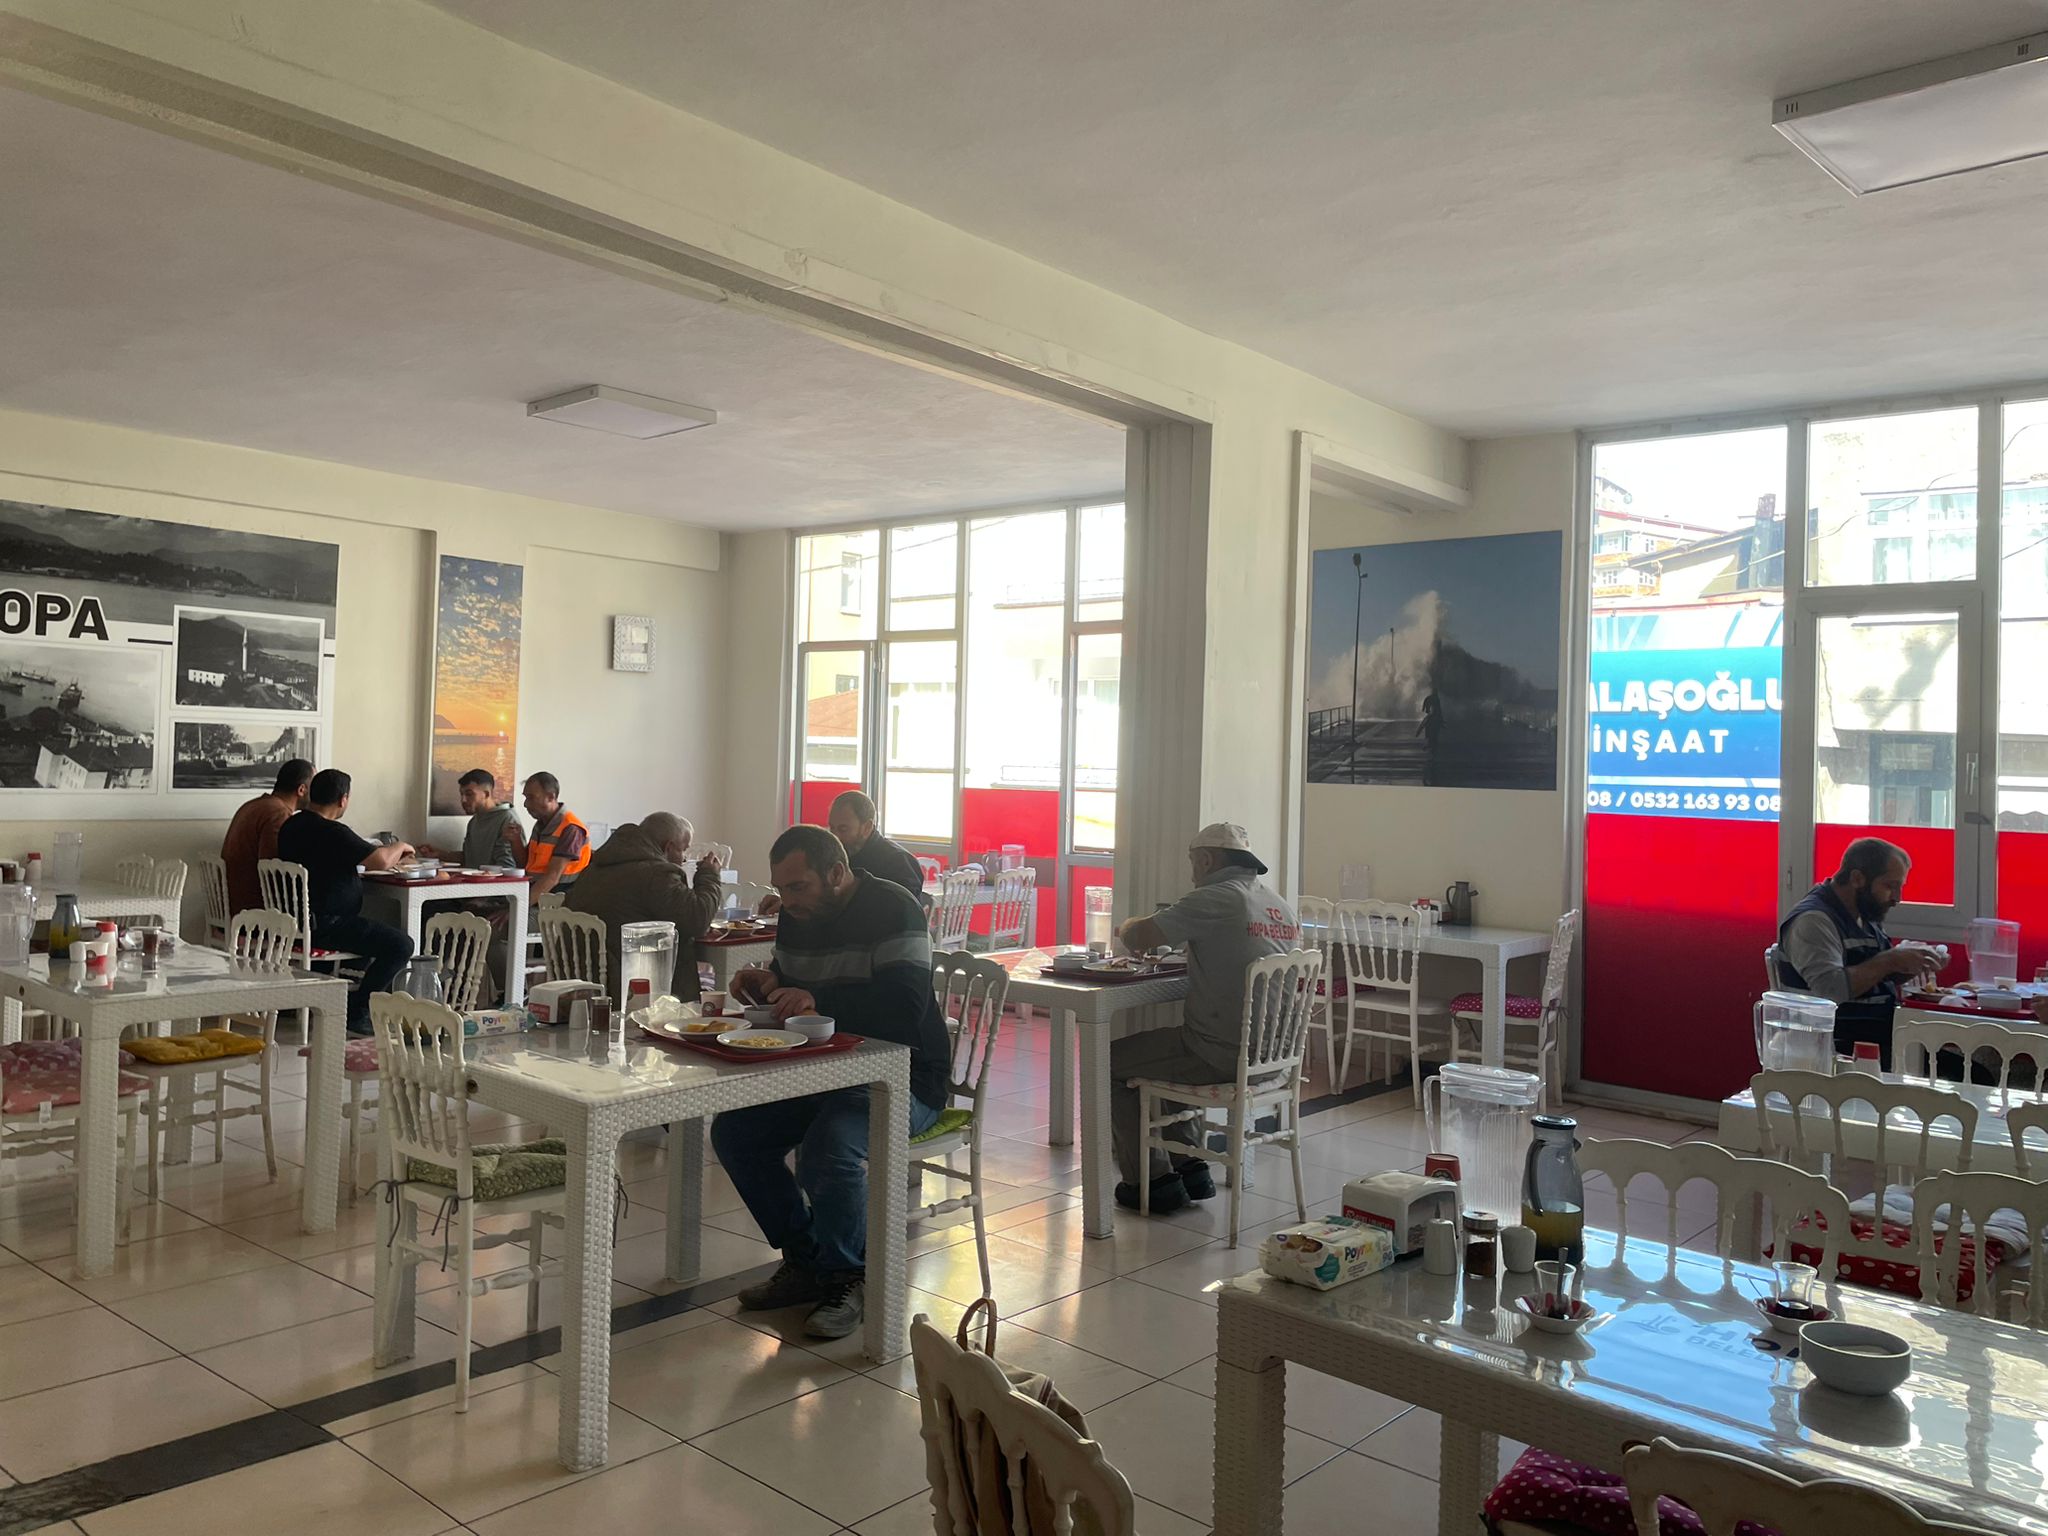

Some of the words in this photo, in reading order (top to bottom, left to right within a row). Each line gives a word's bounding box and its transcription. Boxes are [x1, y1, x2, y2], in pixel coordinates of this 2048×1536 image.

[1593, 723, 1730, 761] İNŞAAT
[1615, 791, 1626, 808] /
[1630, 791, 1679, 809] 0532
[1683, 793, 1720, 810] 163
[1724, 794, 1750, 812] 93
[1754, 794, 1782, 812] 08
[1247, 921, 1269, 938] HOPA
